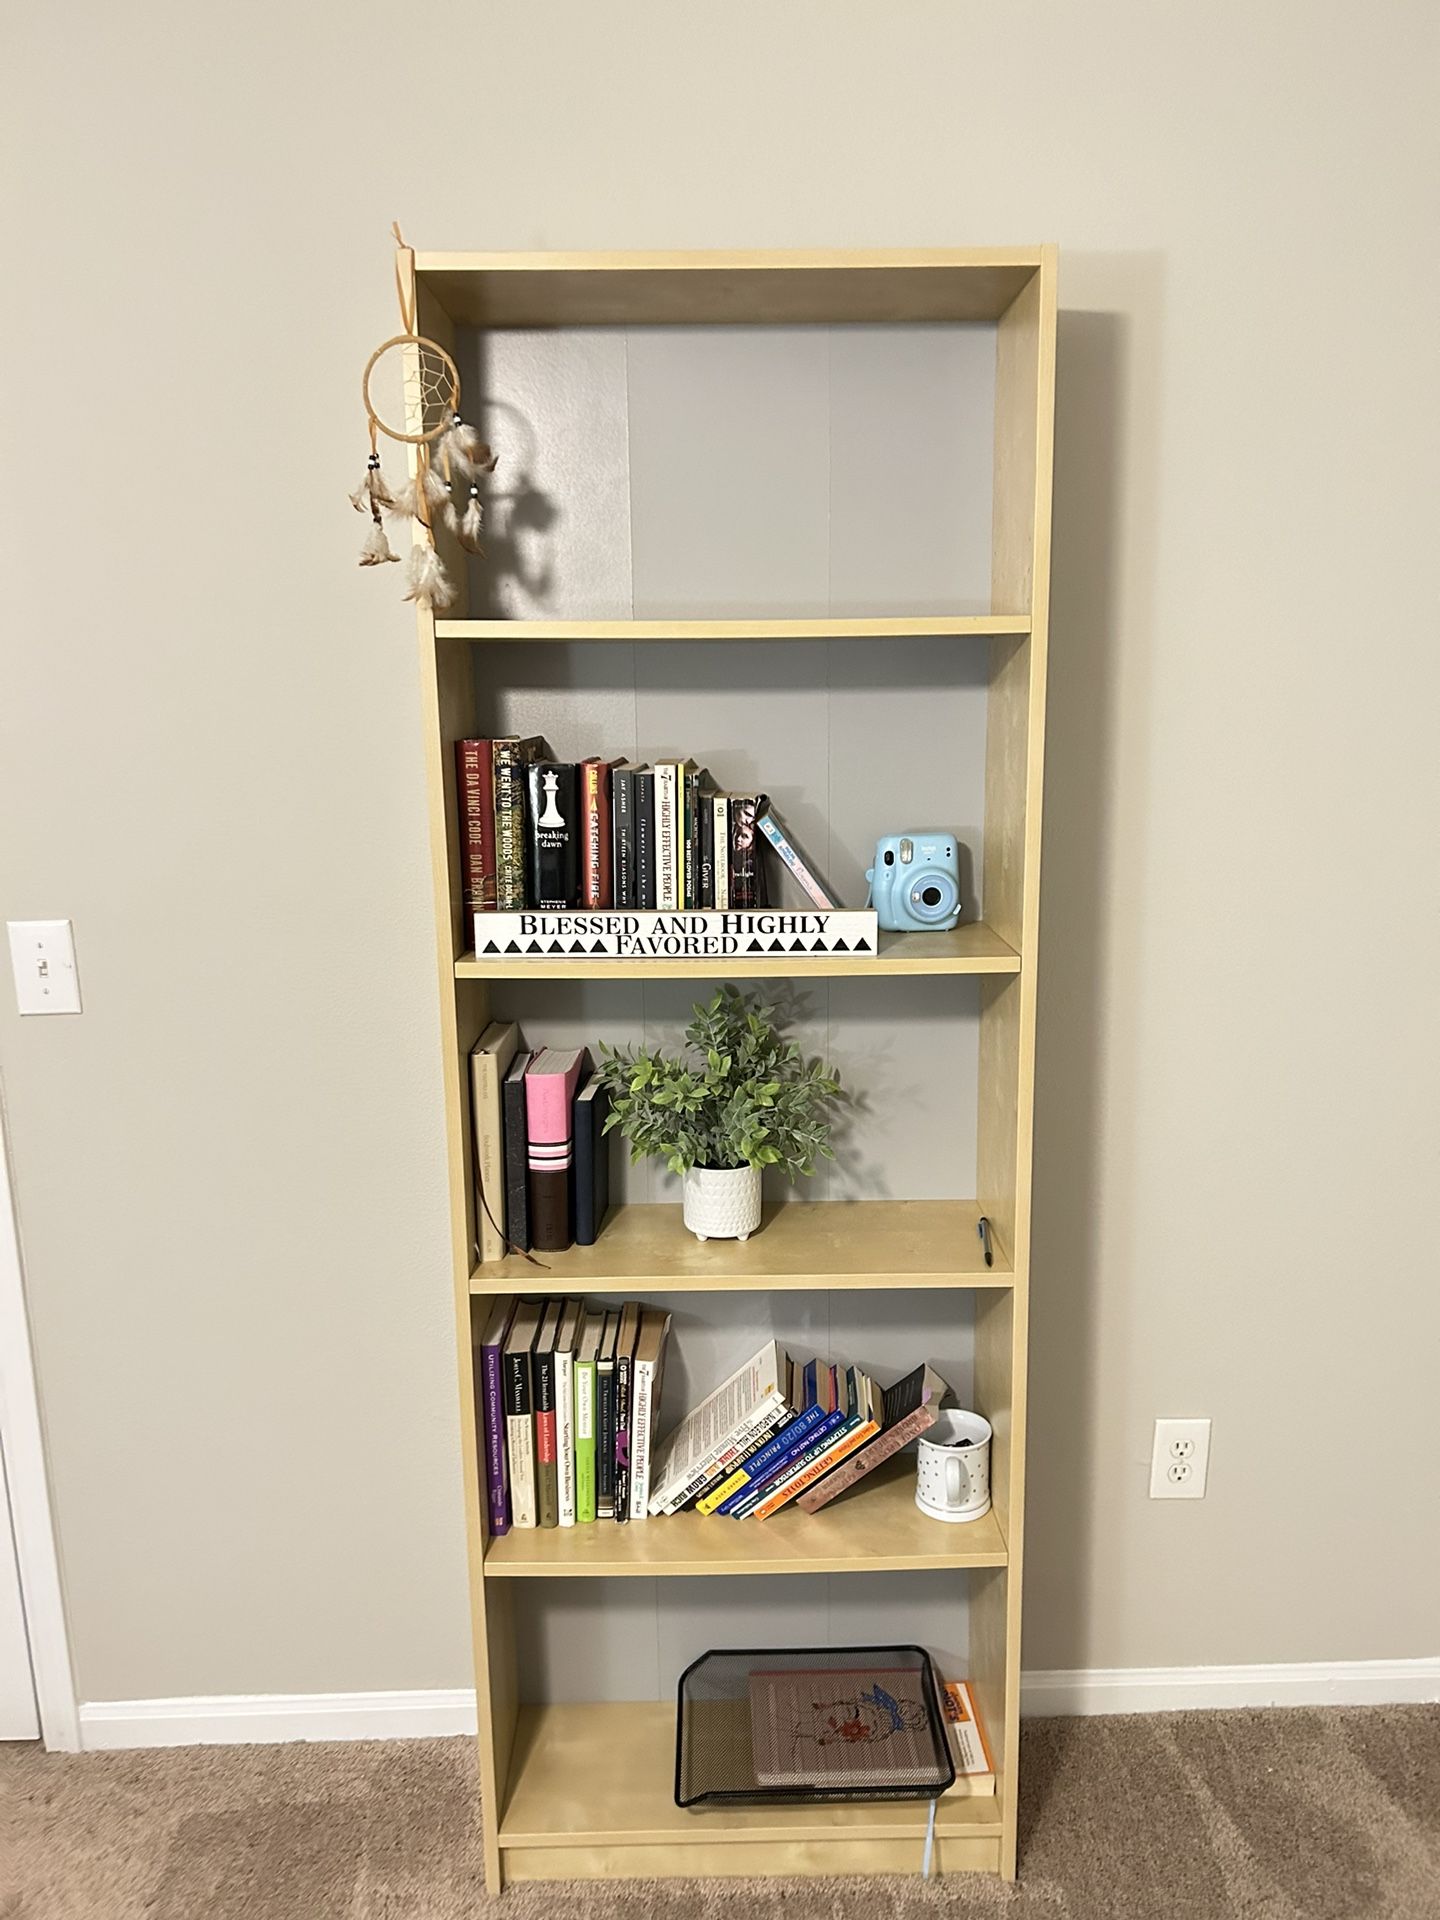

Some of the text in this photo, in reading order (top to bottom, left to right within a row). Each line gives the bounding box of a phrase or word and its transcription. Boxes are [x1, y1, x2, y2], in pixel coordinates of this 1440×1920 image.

[465, 751, 482, 845] THE DA VINCI CODE
[500, 750, 513, 860] WE WENT TO THE WOODS
[661, 801, 671, 829] HIGHLY
[535, 830, 569, 842] breaking
[541, 840, 563, 848] dawn
[590, 813, 600, 898] CATCHING FIRE
[641, 859, 646, 869] on
[661, 830, 672, 872] EFFECTIVE
[470, 854, 485, 911] DAN BROWN
[662, 873, 672, 902] PEOPLE
[702, 863, 712, 889] GIVER
[520, 914, 830, 935] BLESSED AND HIGHLY
[615, 935, 738, 954] FAVORED
[541, 1364, 549, 1375] The
[542, 1383, 550, 1411] Irrefutable
[638, 1392, 647, 1417] HIGHLY
[488, 1354, 499, 1475] UTILIZING COMMUNITY RESOURCES
[747, 1411, 777, 1439] NAPOLEON
[804, 1409, 819, 1424] THE
[887, 1413, 919, 1440] BROKEN
[636, 1418, 646, 1454] EFFECTIVE
[733, 1421, 751, 1438] Five
[736, 1434, 752, 1448] HILL
[779, 1419, 807, 1446] 80/20
[789, 1424, 828, 1457] GETTING PAST NO
[819, 1425, 848, 1450] STEPPING
[543, 1434, 551, 1463] Leadership
[711, 1433, 738, 1457] Minute
[747, 1441, 781, 1473] PRINCIPLE
[803, 1451, 815, 1462] TO
[811, 1445, 822, 1456] UP
[635, 1455, 644, 1479] PEOPLE
[669, 1444, 740, 1507] THINK AND GROW RICH
[685, 1452, 717, 1480] Interview
[772, 1457, 807, 1487] SUPERVISOR
[803, 1455, 833, 1481] GETTING
[781, 1483, 796, 1498] YES
[793, 1477, 805, 1488] TO
